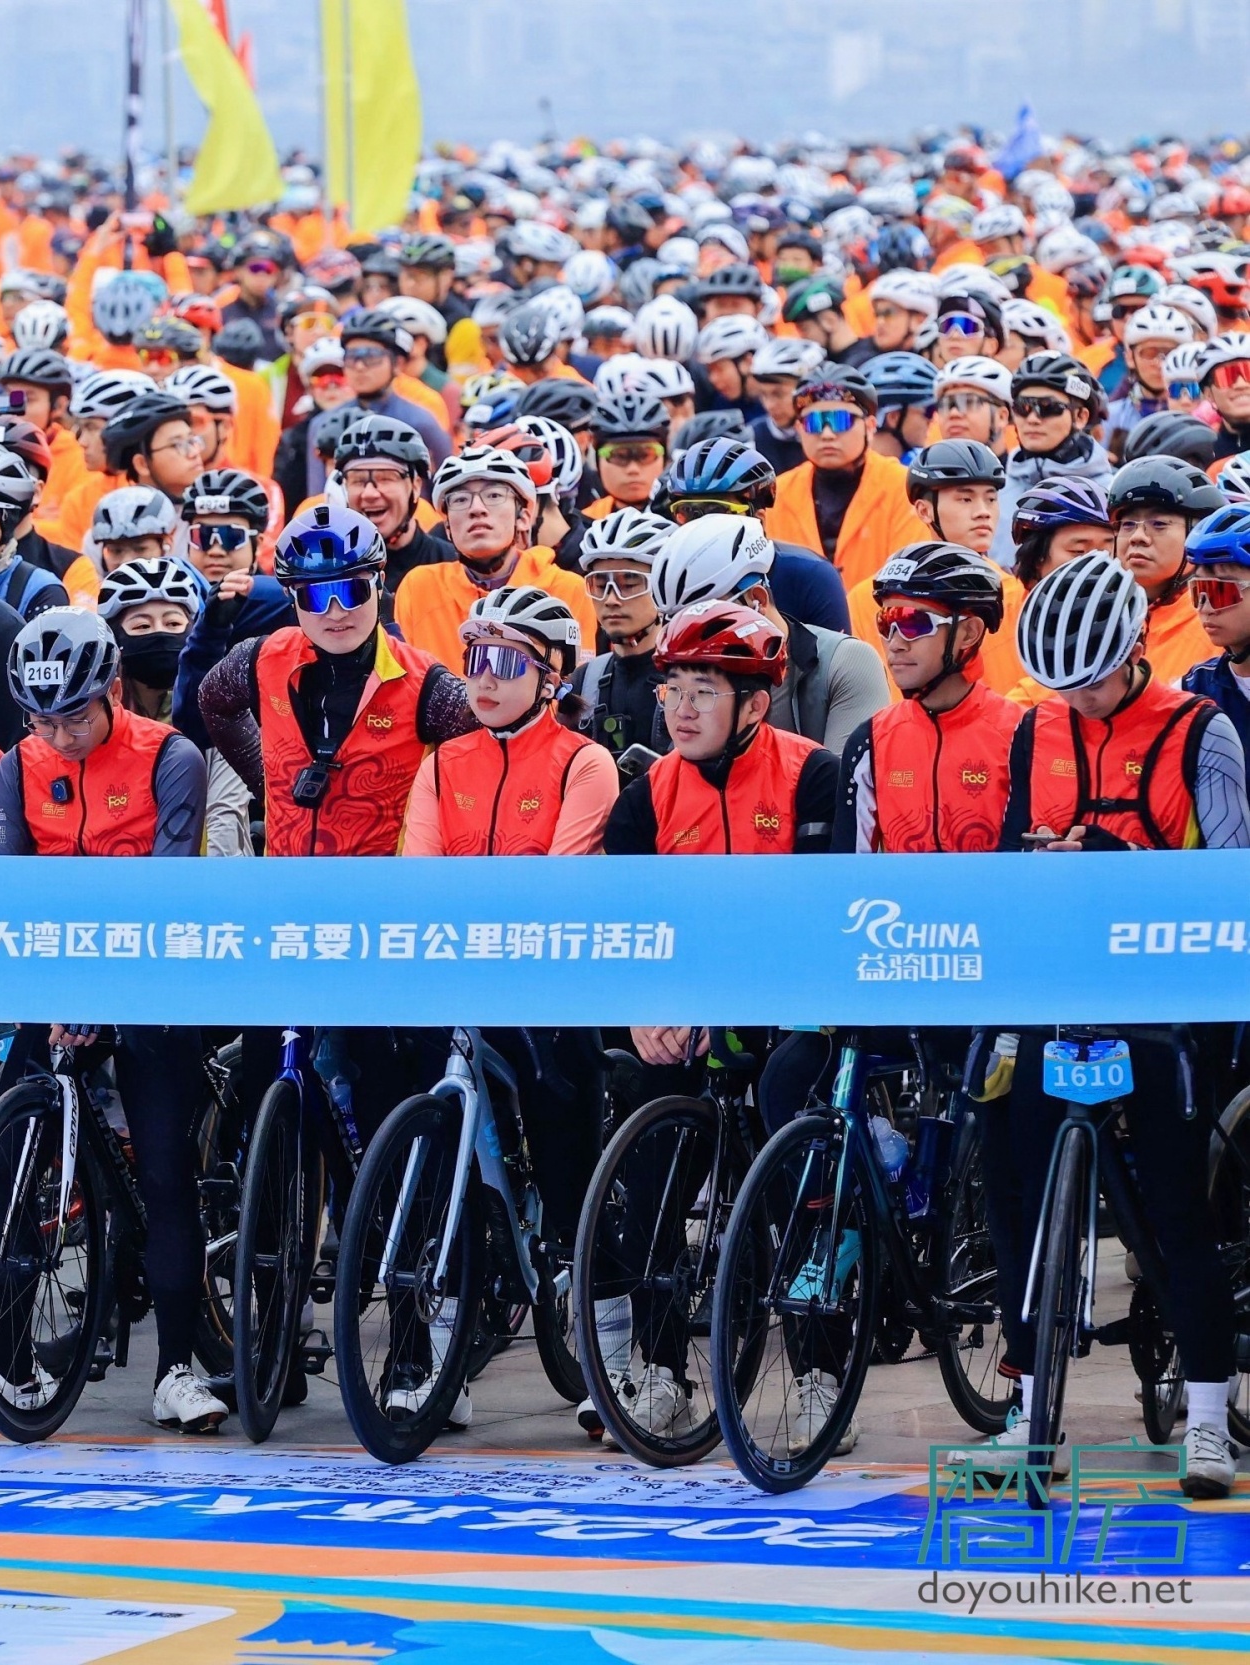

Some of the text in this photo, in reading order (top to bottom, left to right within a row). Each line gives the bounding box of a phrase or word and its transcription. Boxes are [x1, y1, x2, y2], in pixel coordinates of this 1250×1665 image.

[882, 564, 912, 577] 1654
[28, 666, 59, 681] 2161
[1109, 920, 1250, 955] 2024
[856, 953, 982, 982] 益骑中国
[1053, 1063, 1124, 1088] 1610
